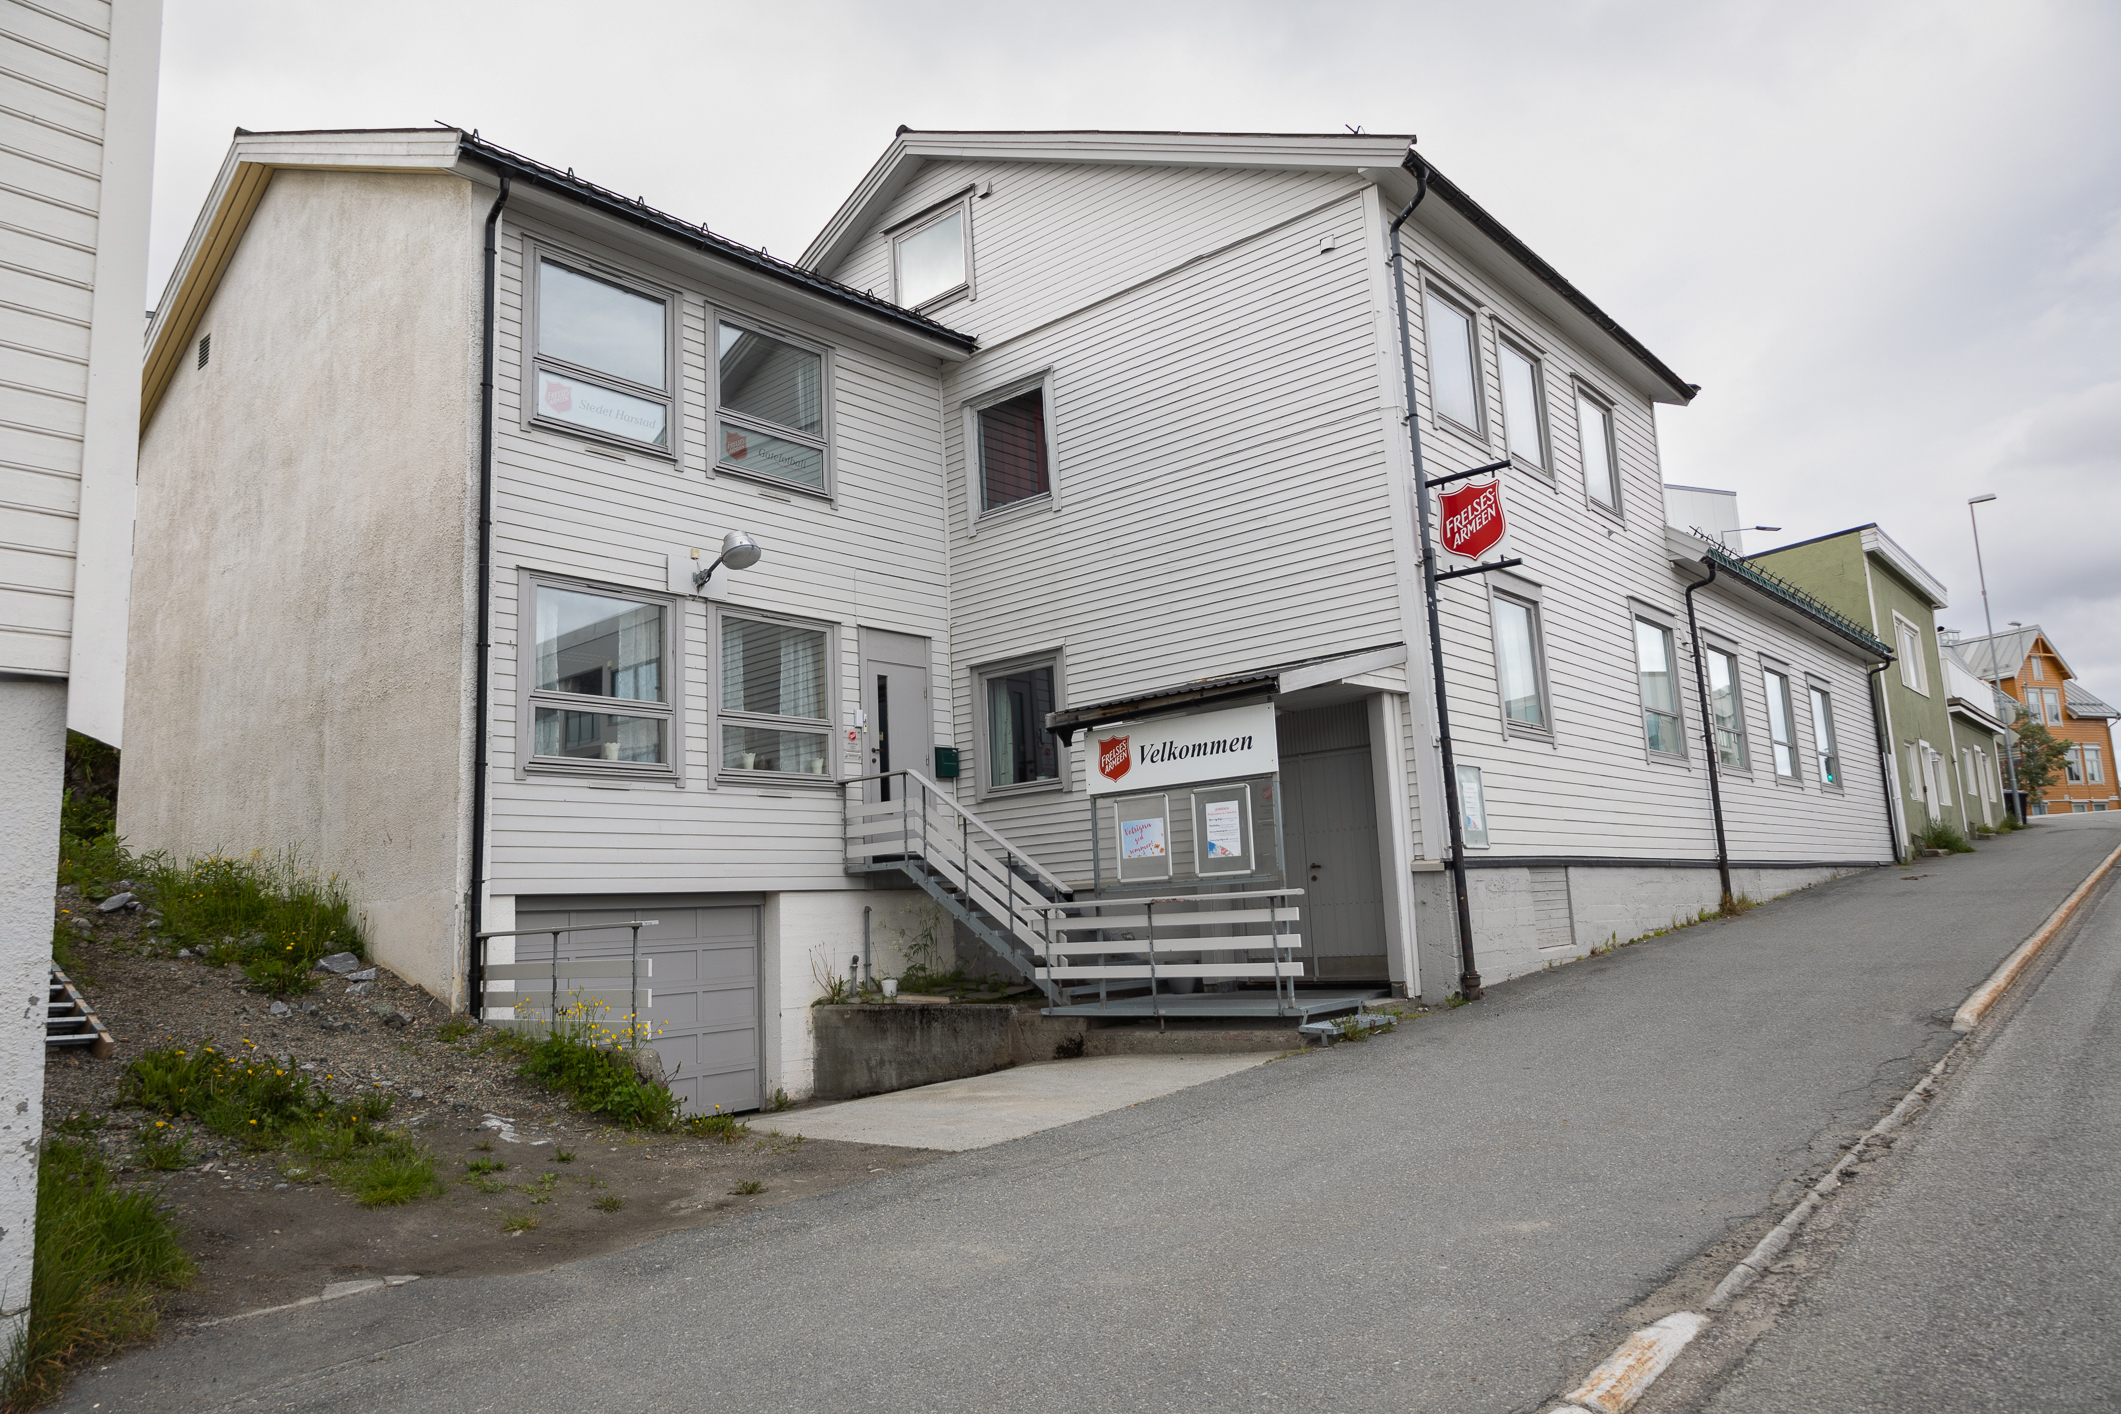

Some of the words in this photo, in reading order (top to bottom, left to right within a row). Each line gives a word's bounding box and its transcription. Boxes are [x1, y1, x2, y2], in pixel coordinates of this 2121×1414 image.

[578, 399, 613, 418] Stedet
[615, 409, 657, 429] Harstad
[1453, 503, 1496, 549] ARMEEN
[1104, 750, 1127, 774] ARMEEN
[1139, 735, 1253, 765] Velkommen
